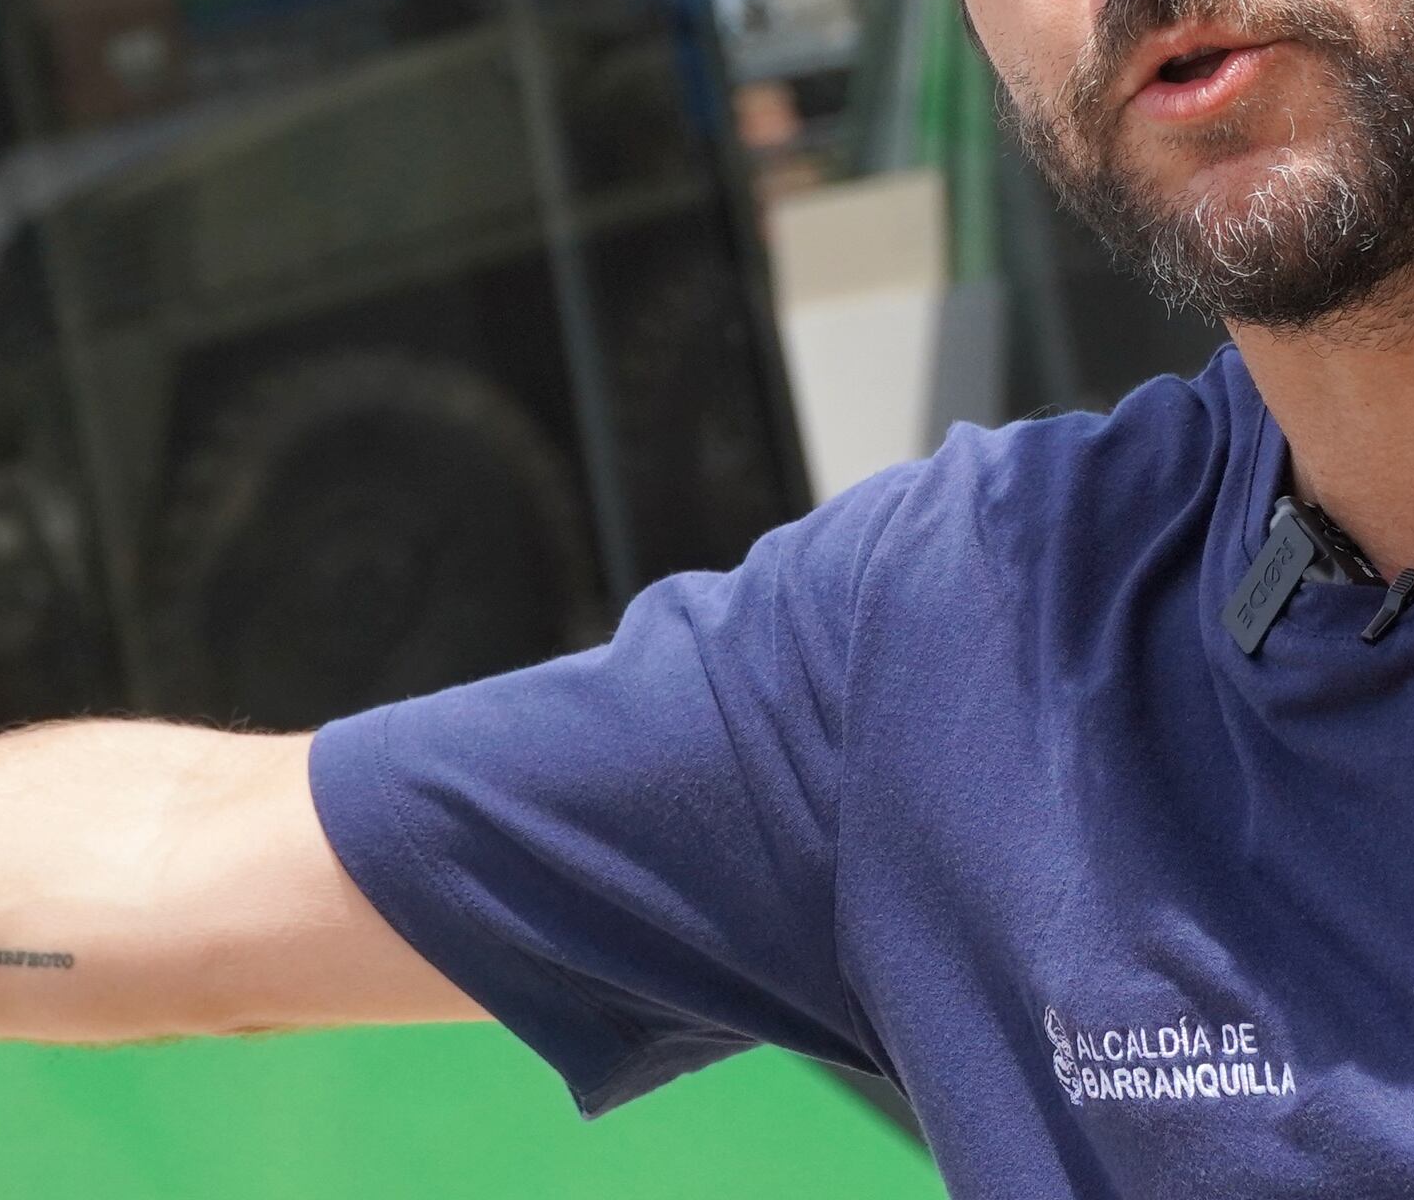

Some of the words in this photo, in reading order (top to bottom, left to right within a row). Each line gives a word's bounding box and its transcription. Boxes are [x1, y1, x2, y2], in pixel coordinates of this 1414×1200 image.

[1076, 1015, 1212, 1062] ALCALDÍA
[1221, 1022, 1258, 1056] DE
[1081, 1062, 1297, 1101] BARRANQUILLA
